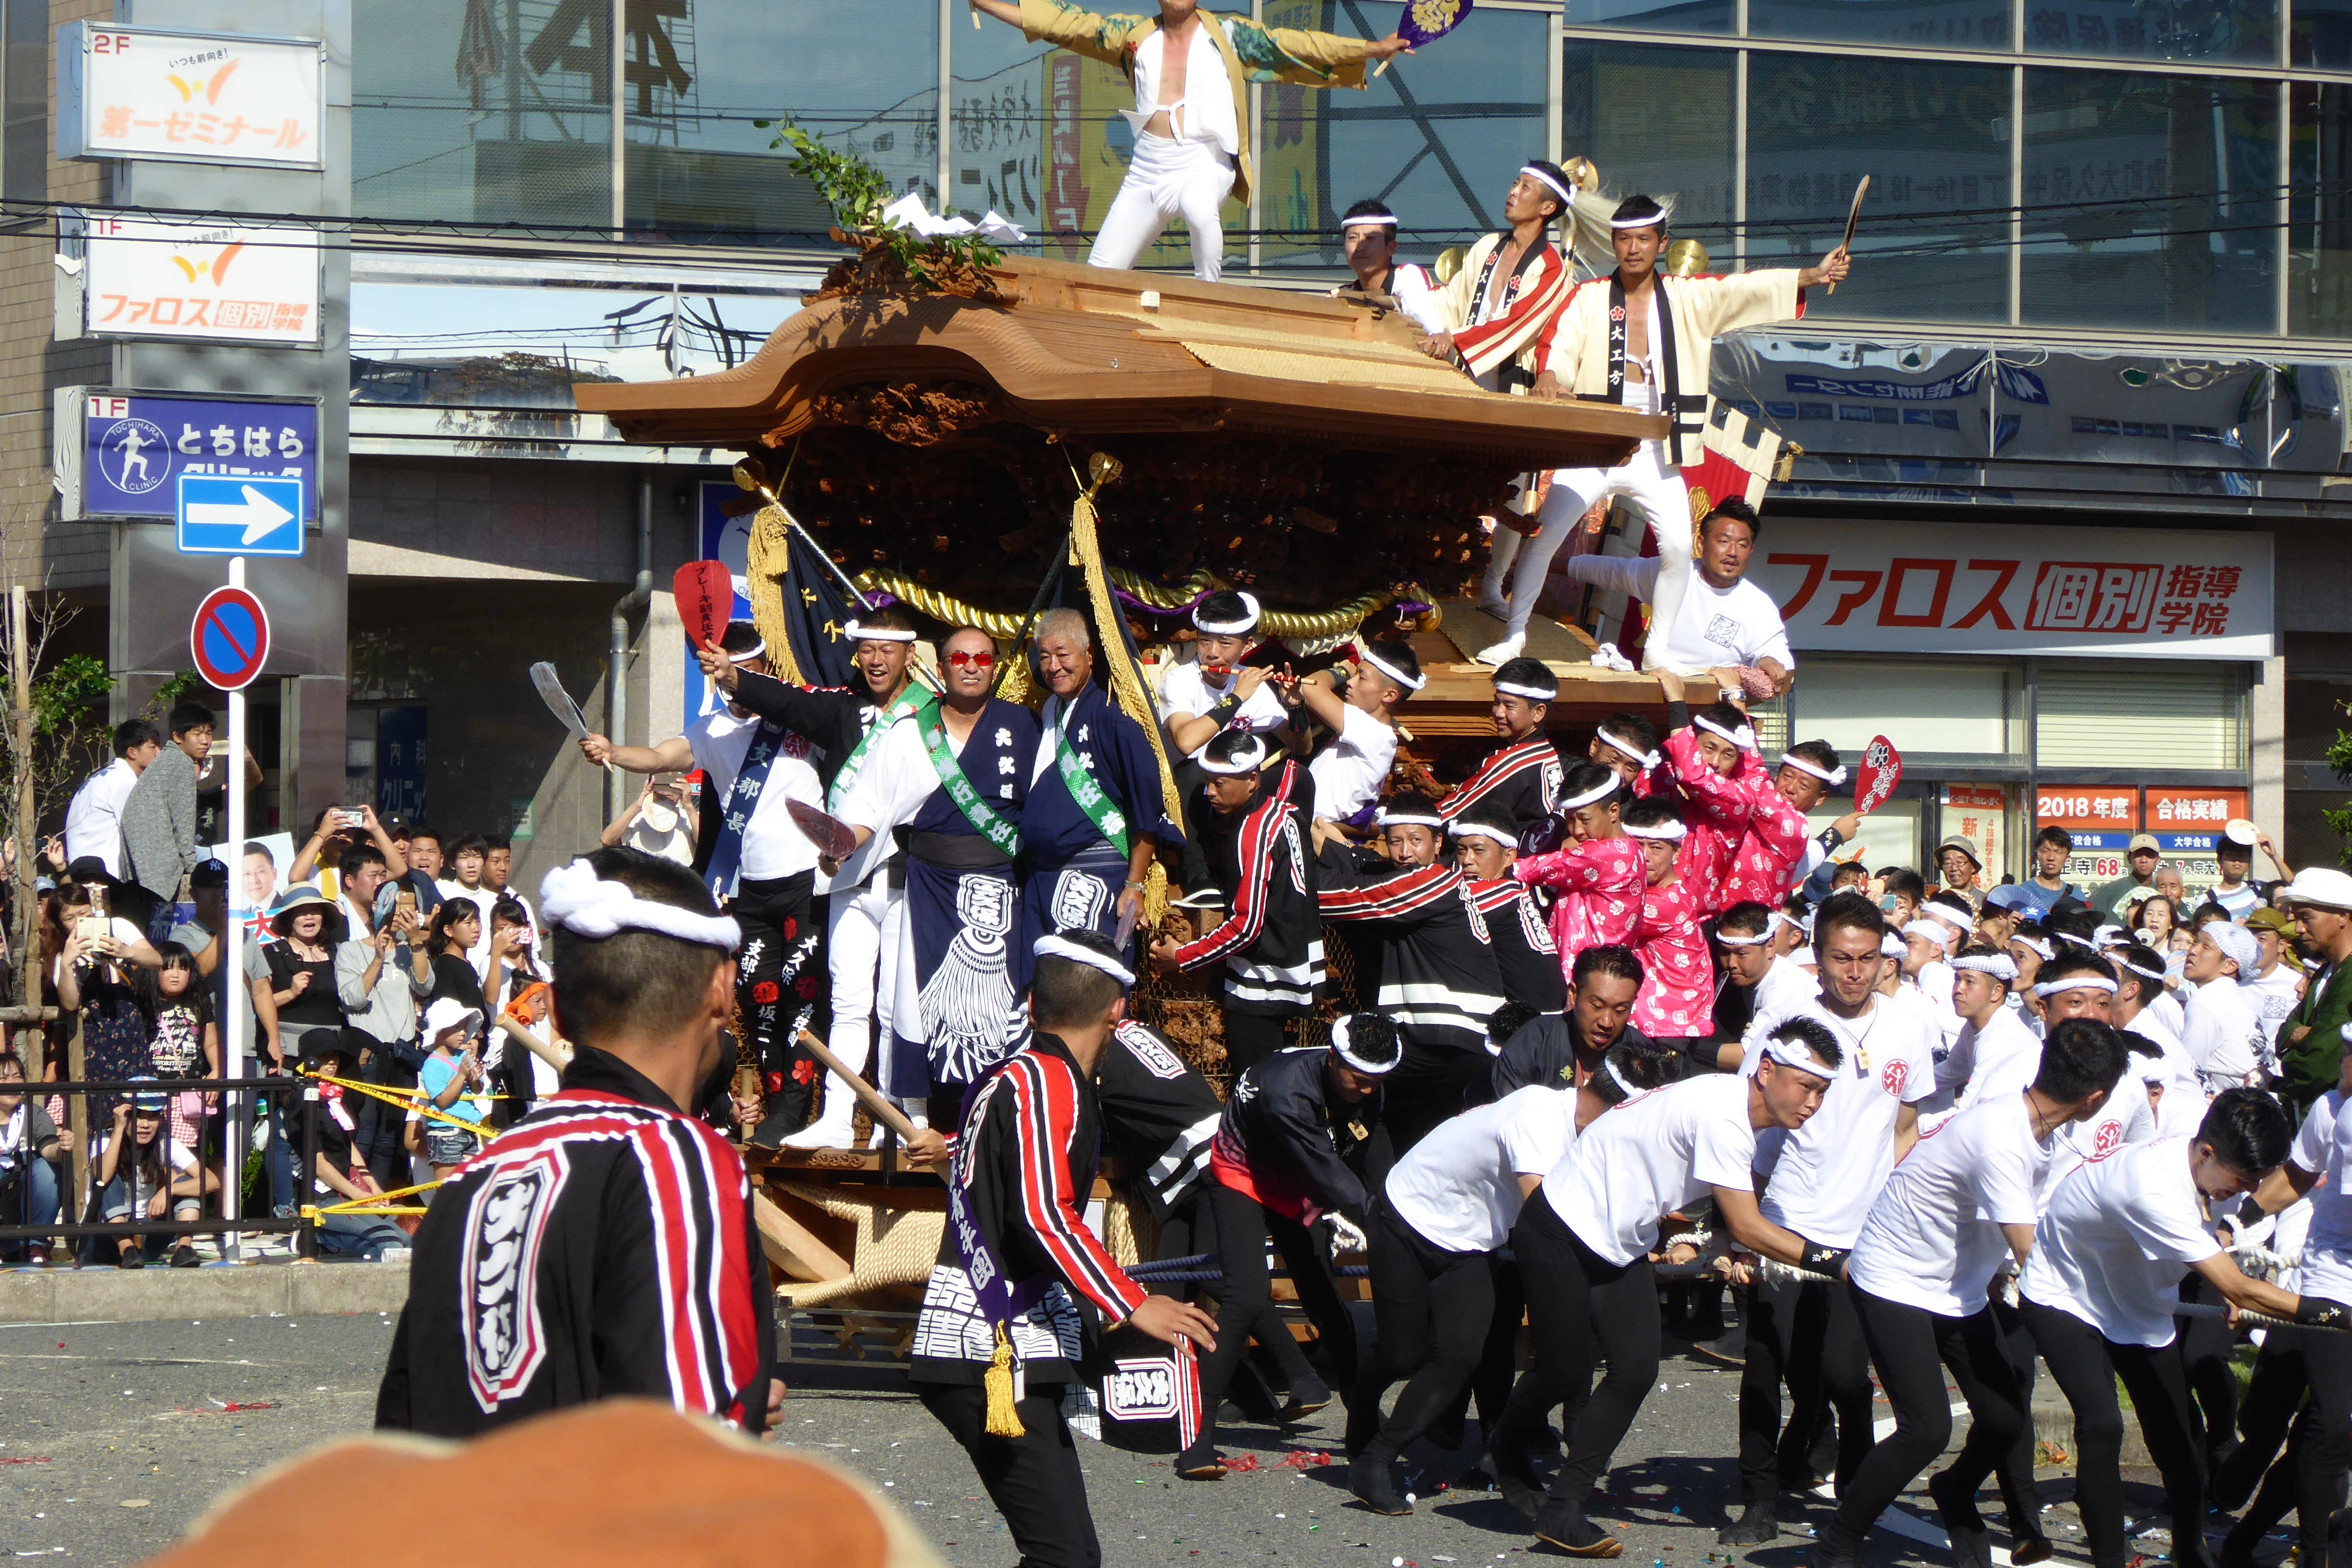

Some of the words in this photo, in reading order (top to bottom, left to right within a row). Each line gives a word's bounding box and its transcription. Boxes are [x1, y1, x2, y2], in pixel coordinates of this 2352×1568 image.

[94, 35, 130, 54] 2F
[99, 106, 308, 149] 第一ゼミナール
[99, 219, 122, 235] 1F
[1609, 325, 1624, 385] 大工方
[91, 399, 126, 417] 1F
[110, 421, 160, 439] TOCHIHARA
[177, 423, 304, 458] とちはら
[129, 477, 158, 491] CLINIC
[2164, 565, 2243, 599] 指導
[2156, 602, 2229, 636] 学院
[1078, 724, 1101, 788] 大久
[726, 743, 772, 835] 支部長
[2038, 797, 2089, 818] 2018
[2094, 797, 2129, 819] 年度
[2156, 798, 2228, 821] 合格実績
[2174, 836, 2211, 848] 大学合格
[2194, 861, 2215, 875] 京大
